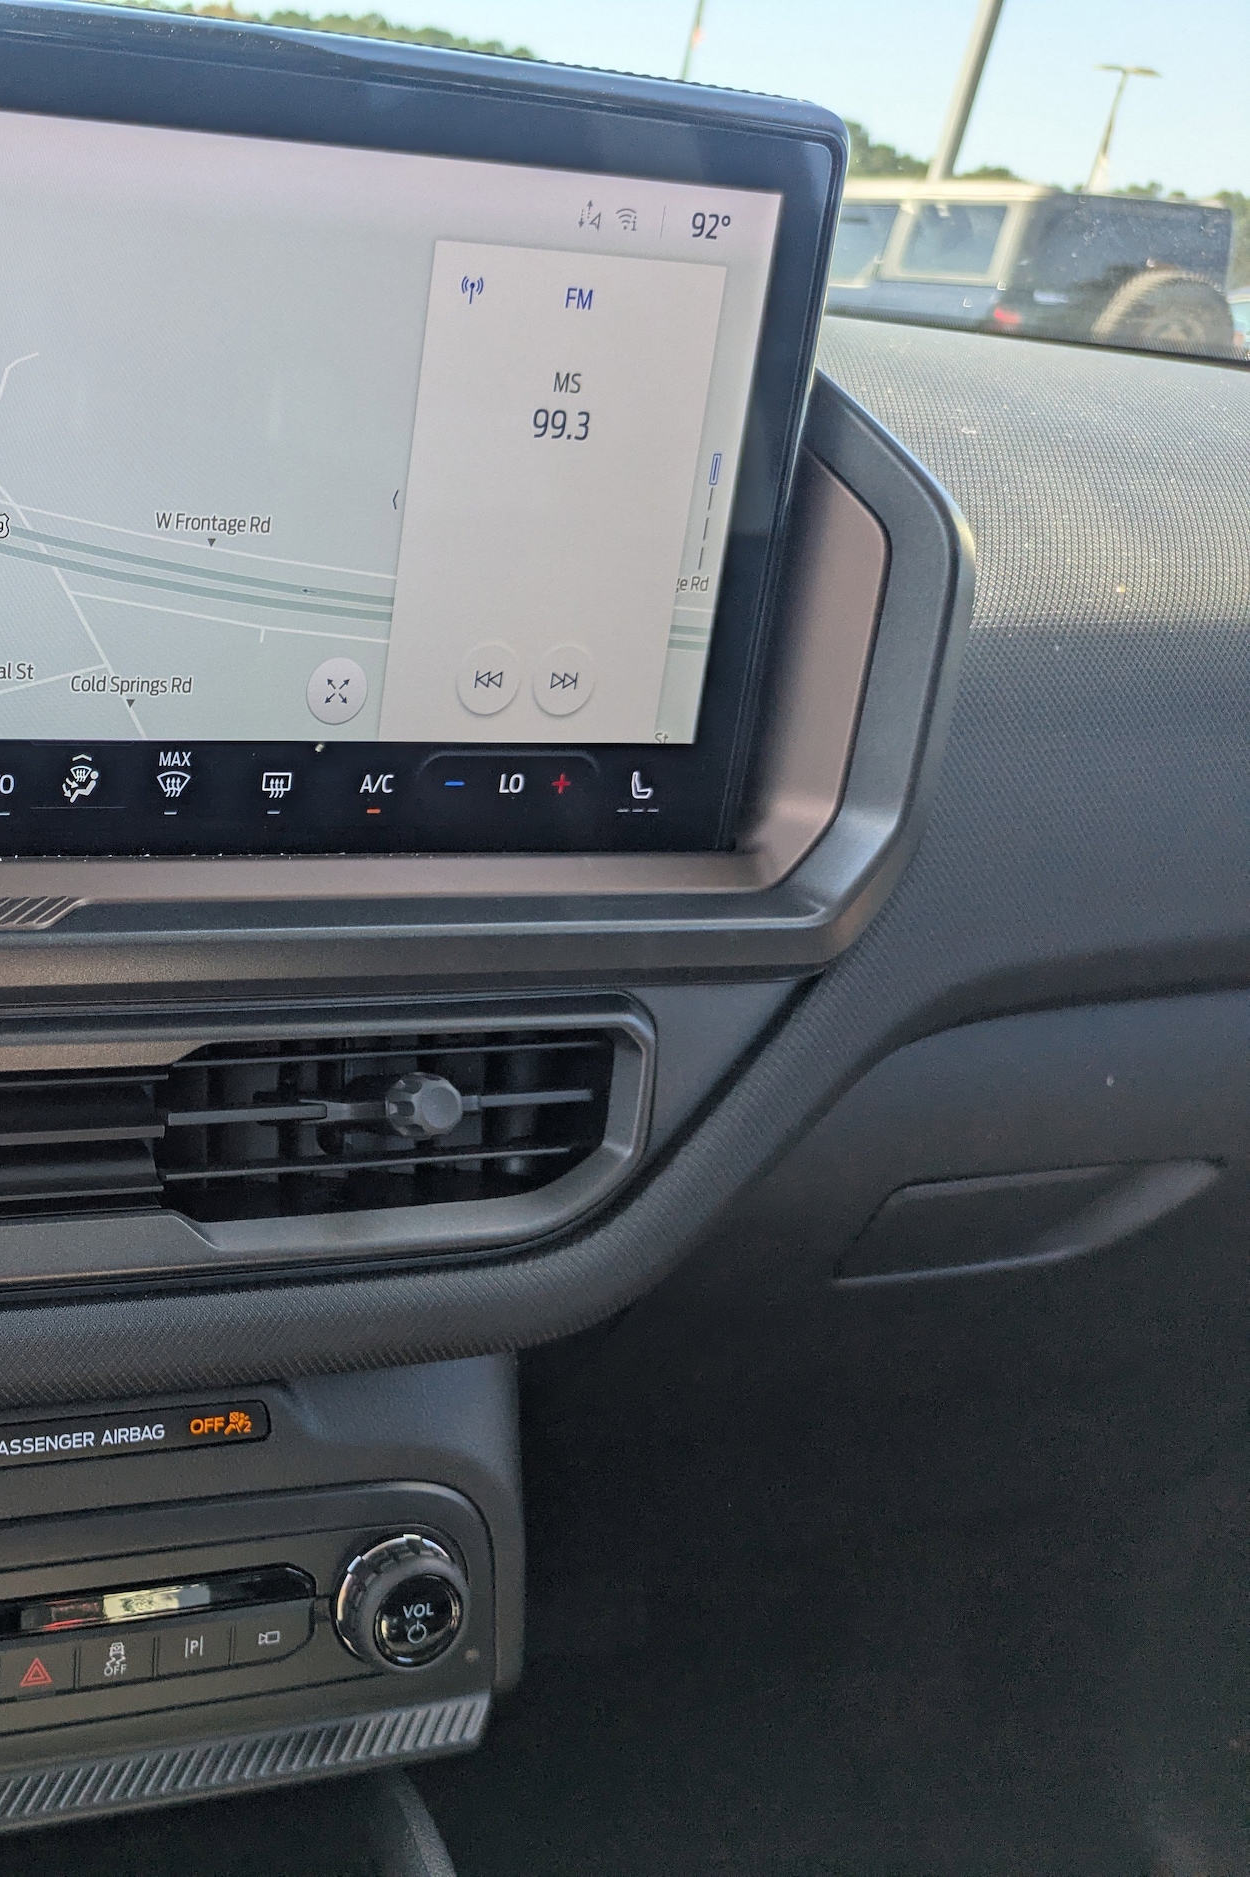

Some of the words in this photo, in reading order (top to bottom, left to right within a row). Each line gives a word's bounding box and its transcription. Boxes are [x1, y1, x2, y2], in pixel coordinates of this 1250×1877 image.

[564, 287, 594, 311] FM
[552, 371, 582, 394] MS
[532, 408, 591, 441] 99.3
[155, 512, 174, 530] W
[175, 513, 246, 535] Frontage
[250, 517, 271, 534] Rd
[690, 575, 710, 592] Rd
[15, 663, 34, 680] St
[70, 675, 106, 693] Cold
[109, 677, 167, 696] Springs
[171, 679, 192, 694] Rd
[158, 751, 191, 767] MAX
[359, 774, 394, 793] A/C
[498, 773, 525, 794] LO
[101, 1423, 166, 1446] AIRBAG
[190, 1416, 225, 1434] OFF
[402, 1601, 435, 1620] VOL
[103, 1663, 128, 1677] OFF
